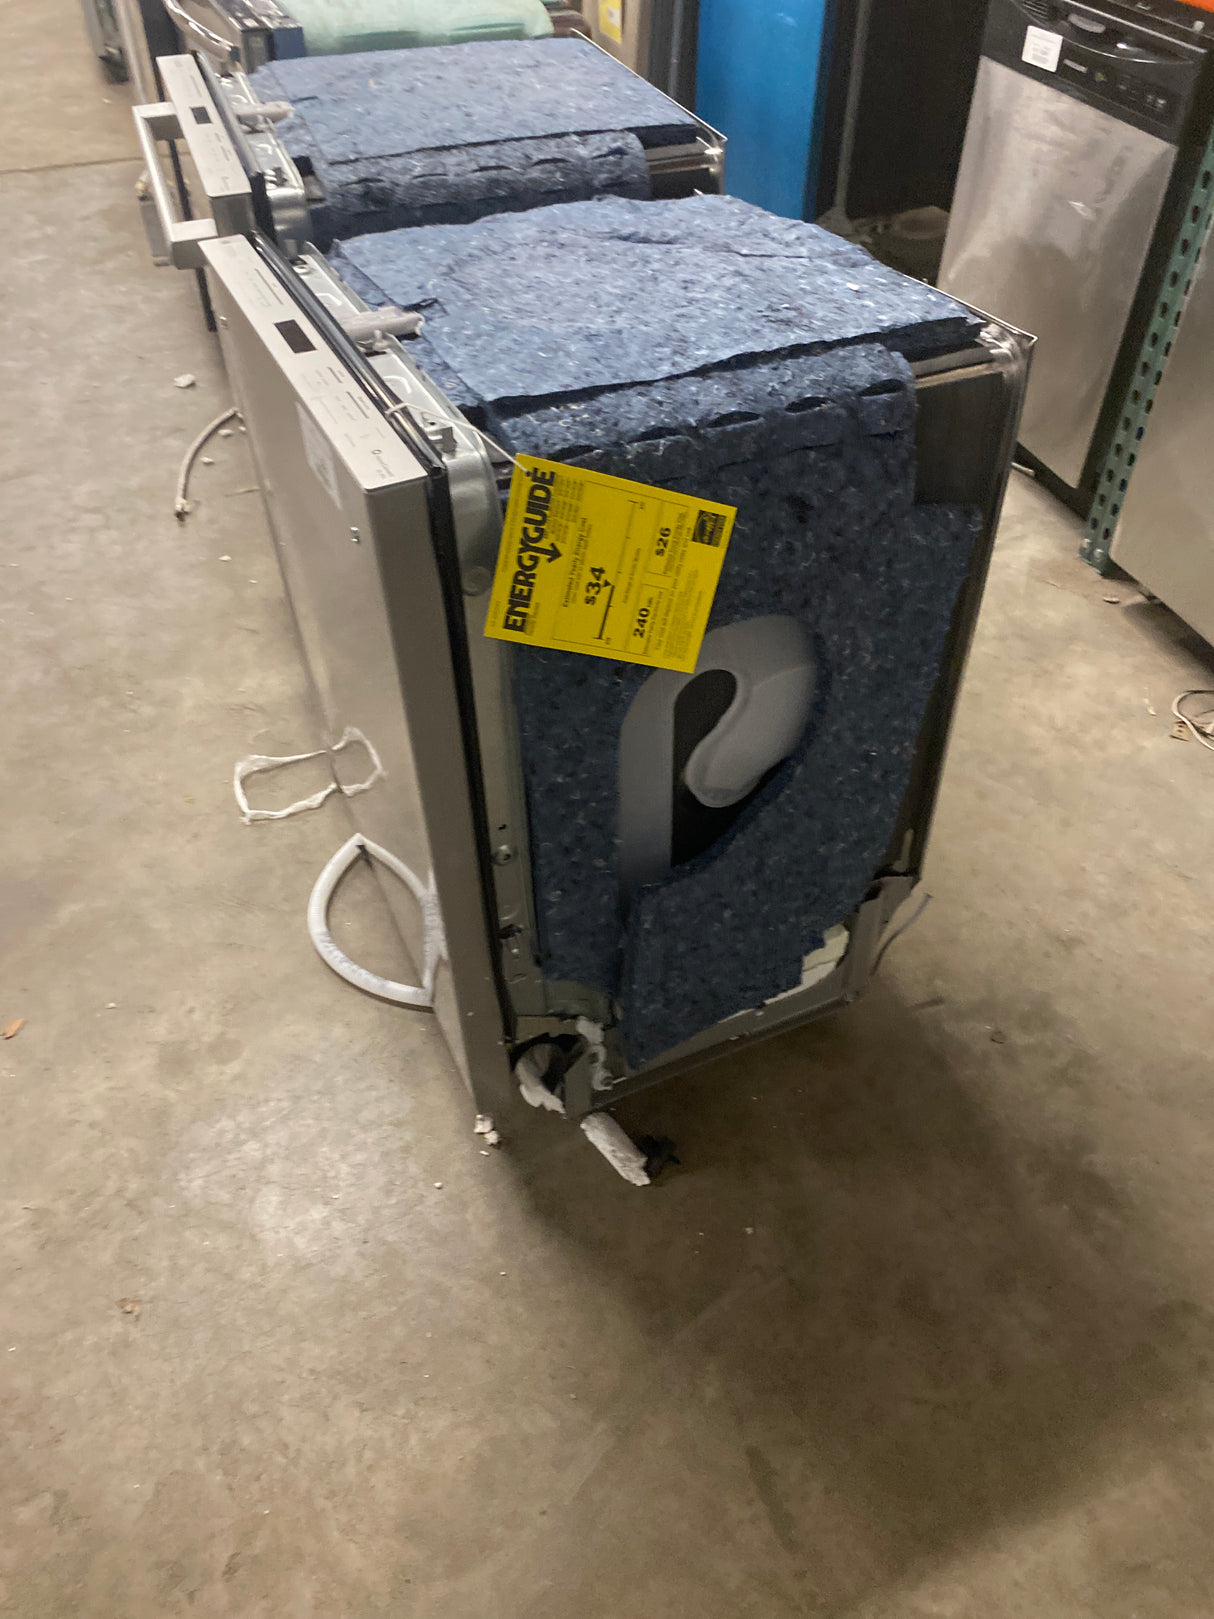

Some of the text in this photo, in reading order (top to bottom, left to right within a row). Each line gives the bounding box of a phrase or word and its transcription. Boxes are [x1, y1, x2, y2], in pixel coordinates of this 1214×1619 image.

[503, 467, 556, 632] ENERGYGUIDE
[655, 527, 671, 557] $26
[584, 567, 605, 606] $34
[633, 607, 650, 638] 240
